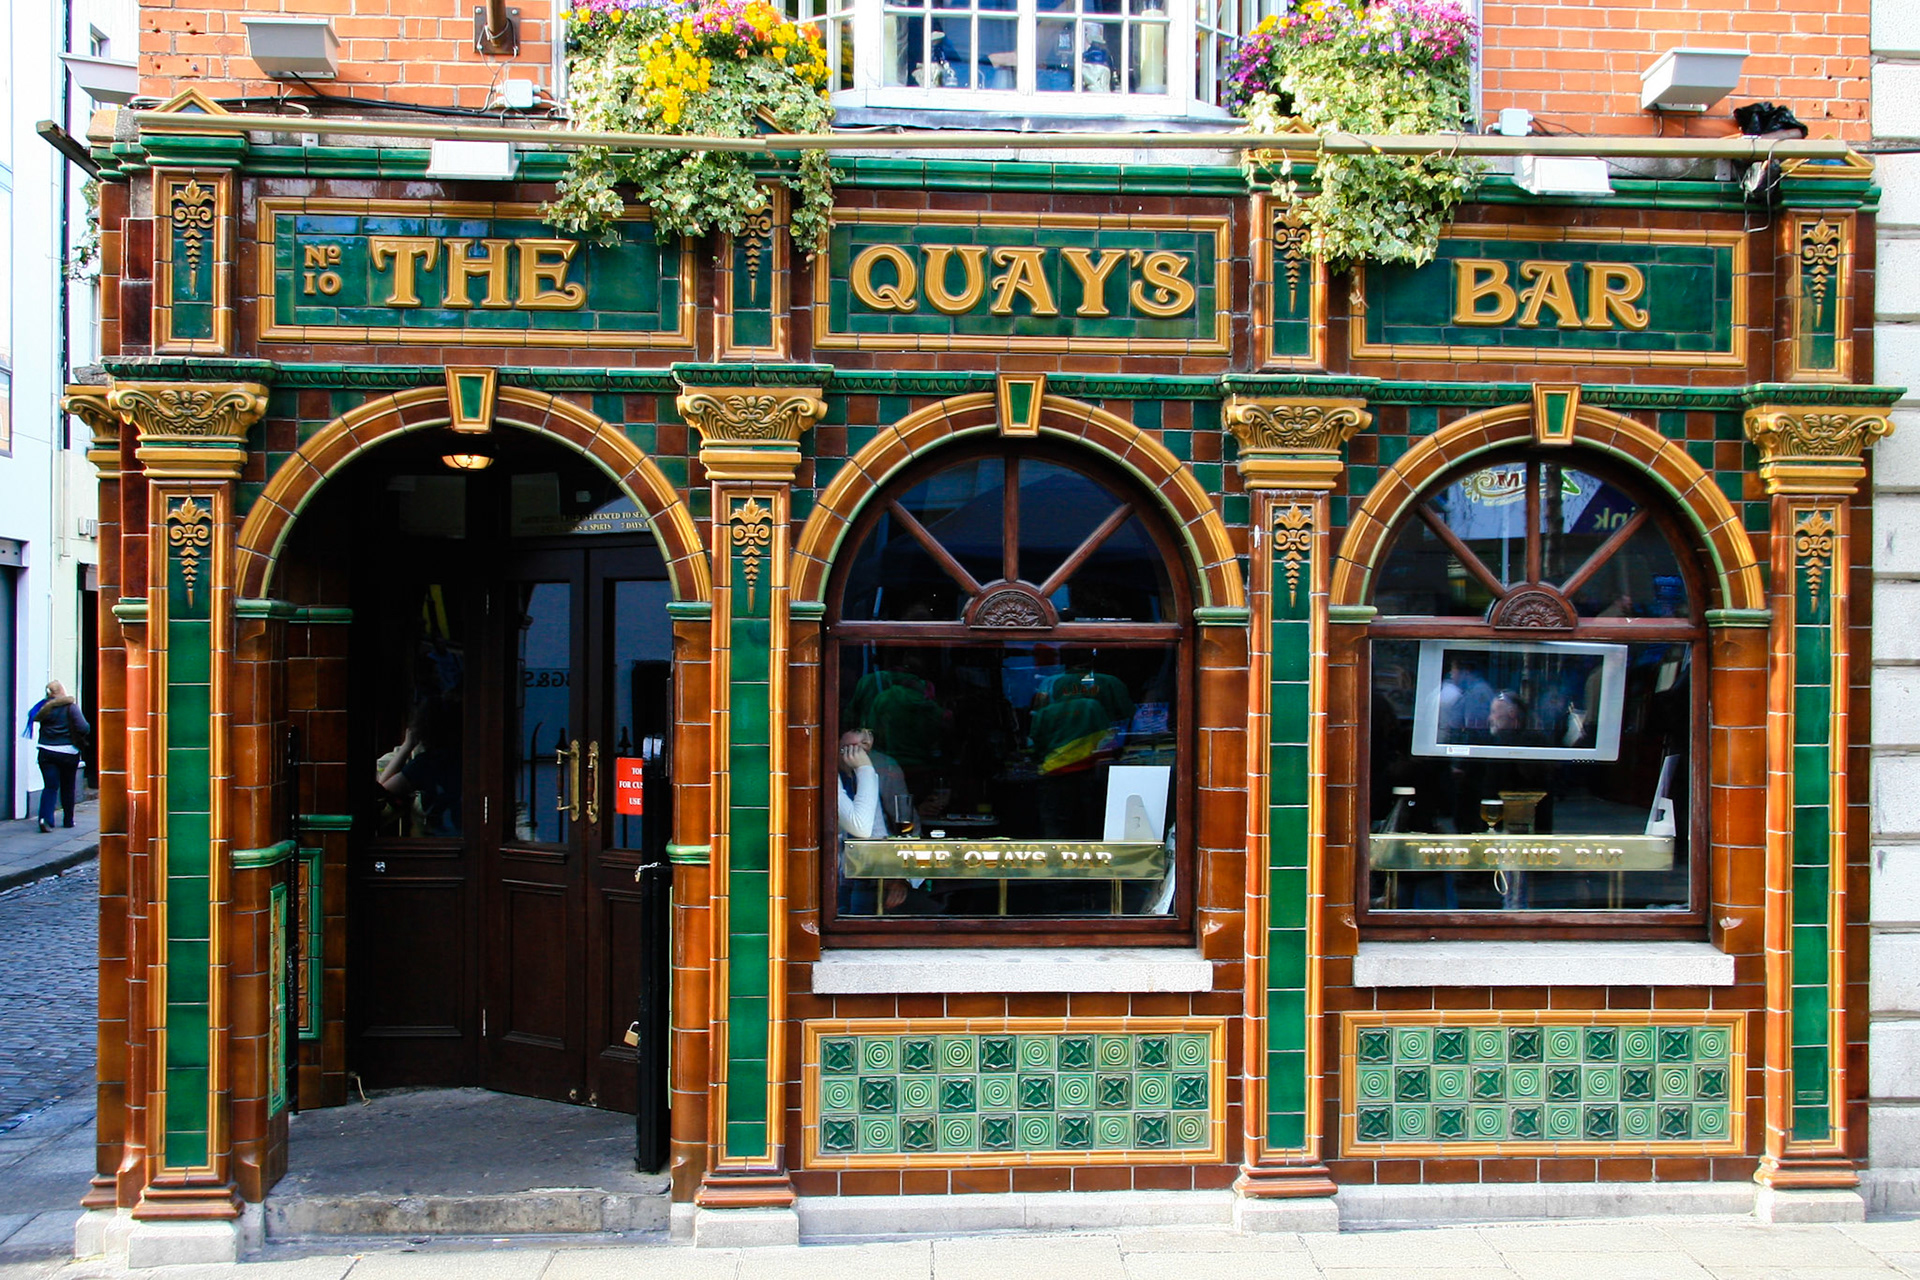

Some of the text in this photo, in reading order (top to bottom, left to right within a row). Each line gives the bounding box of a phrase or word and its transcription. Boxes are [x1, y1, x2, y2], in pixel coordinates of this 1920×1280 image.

[369, 236, 1650, 331] THE QUAY'S BAR
[619, 780, 631, 789] FOR
[629, 797, 642, 806] USE
[897, 850, 951, 869] THE
[1061, 851, 1114, 870] BAR
[1418, 847, 1470, 866] THE
[1574, 848, 1624, 866] BAR
